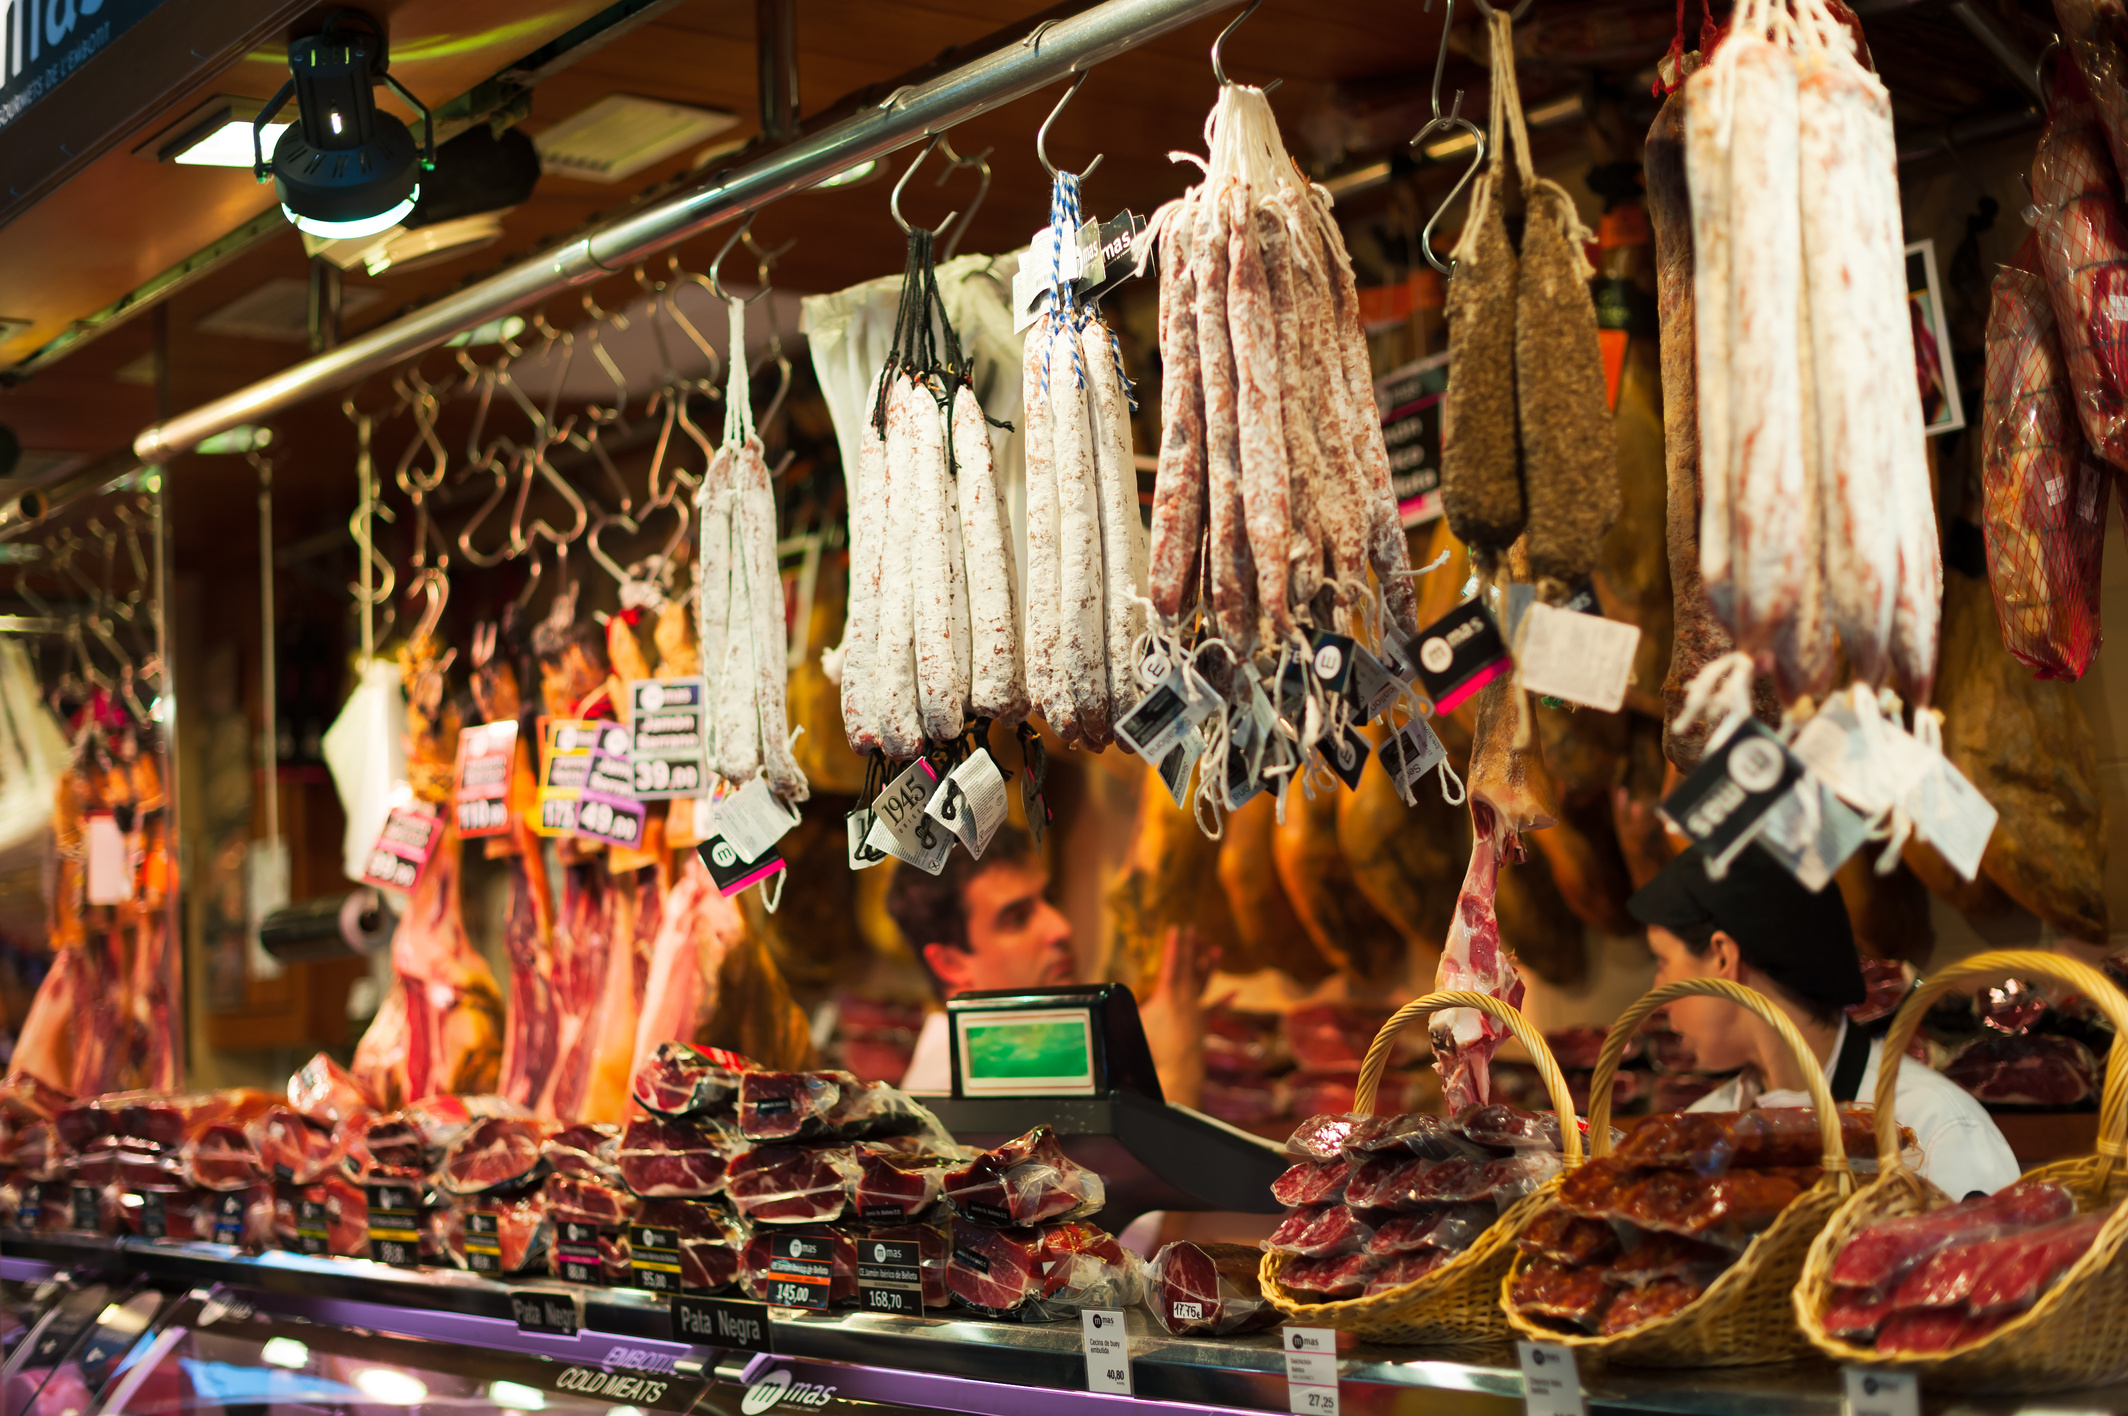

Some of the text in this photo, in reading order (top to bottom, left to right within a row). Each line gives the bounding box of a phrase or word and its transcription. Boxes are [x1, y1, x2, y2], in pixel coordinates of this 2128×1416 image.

[1083, 240, 1099, 262] mas
[1101, 231, 1131, 261] mas
[1446, 616, 1485, 648] mas
[881, 772, 926, 827] 1945
[1686, 777, 1748, 840] mas
[802, 1243, 817, 1255] mas
[886, 1247, 902, 1259] mas
[813, 1264, 829, 1275] Bellota
[895, 1270, 902, 1280] de
[902, 1270, 918, 1280] Bellota
[776, 1283, 809, 1303] 145,00
[869, 1290, 902, 1310] 168,70
[513, 1299, 542, 1326] Pata
[1102, 1315, 1114, 1324] mas
[680, 1306, 762, 1346] Pata Negra
[1090, 1338, 1120, 1349] Cecina de buey
[1091, 1346, 1110, 1355] embutida
[1303, 1337, 1320, 1347] mas
[555, 1367, 669, 1404] COLD MEATS
[1107, 1369, 1125, 1382] 40,80
[782, 1381, 837, 1407] mas
[1308, 1393, 1335, 1410] 27,25
